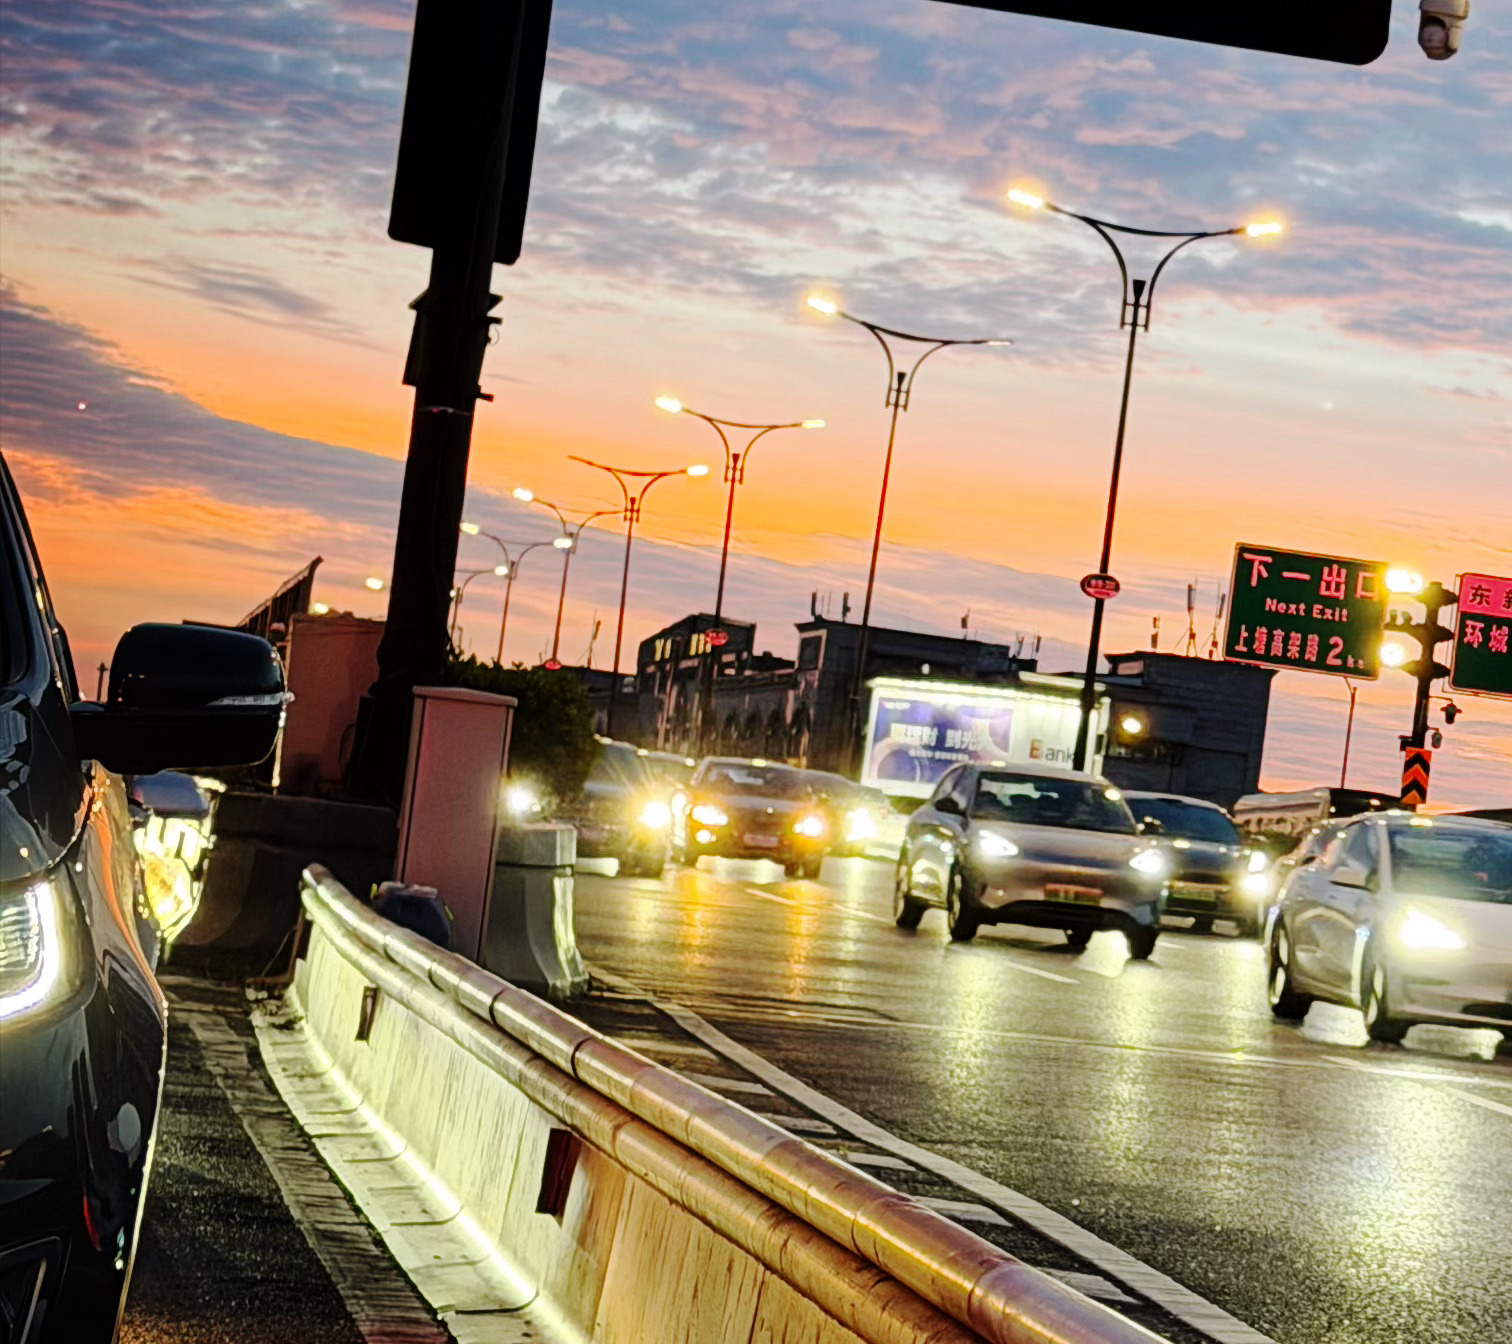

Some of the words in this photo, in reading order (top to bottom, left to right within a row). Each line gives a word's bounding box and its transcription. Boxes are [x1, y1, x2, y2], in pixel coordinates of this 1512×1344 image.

[1242, 552, 1379, 600] 下一出口
[1264, 597, 1306, 616] Next
[1311, 603, 1350, 623] Exit
[890, 723, 939, 747] 理财
